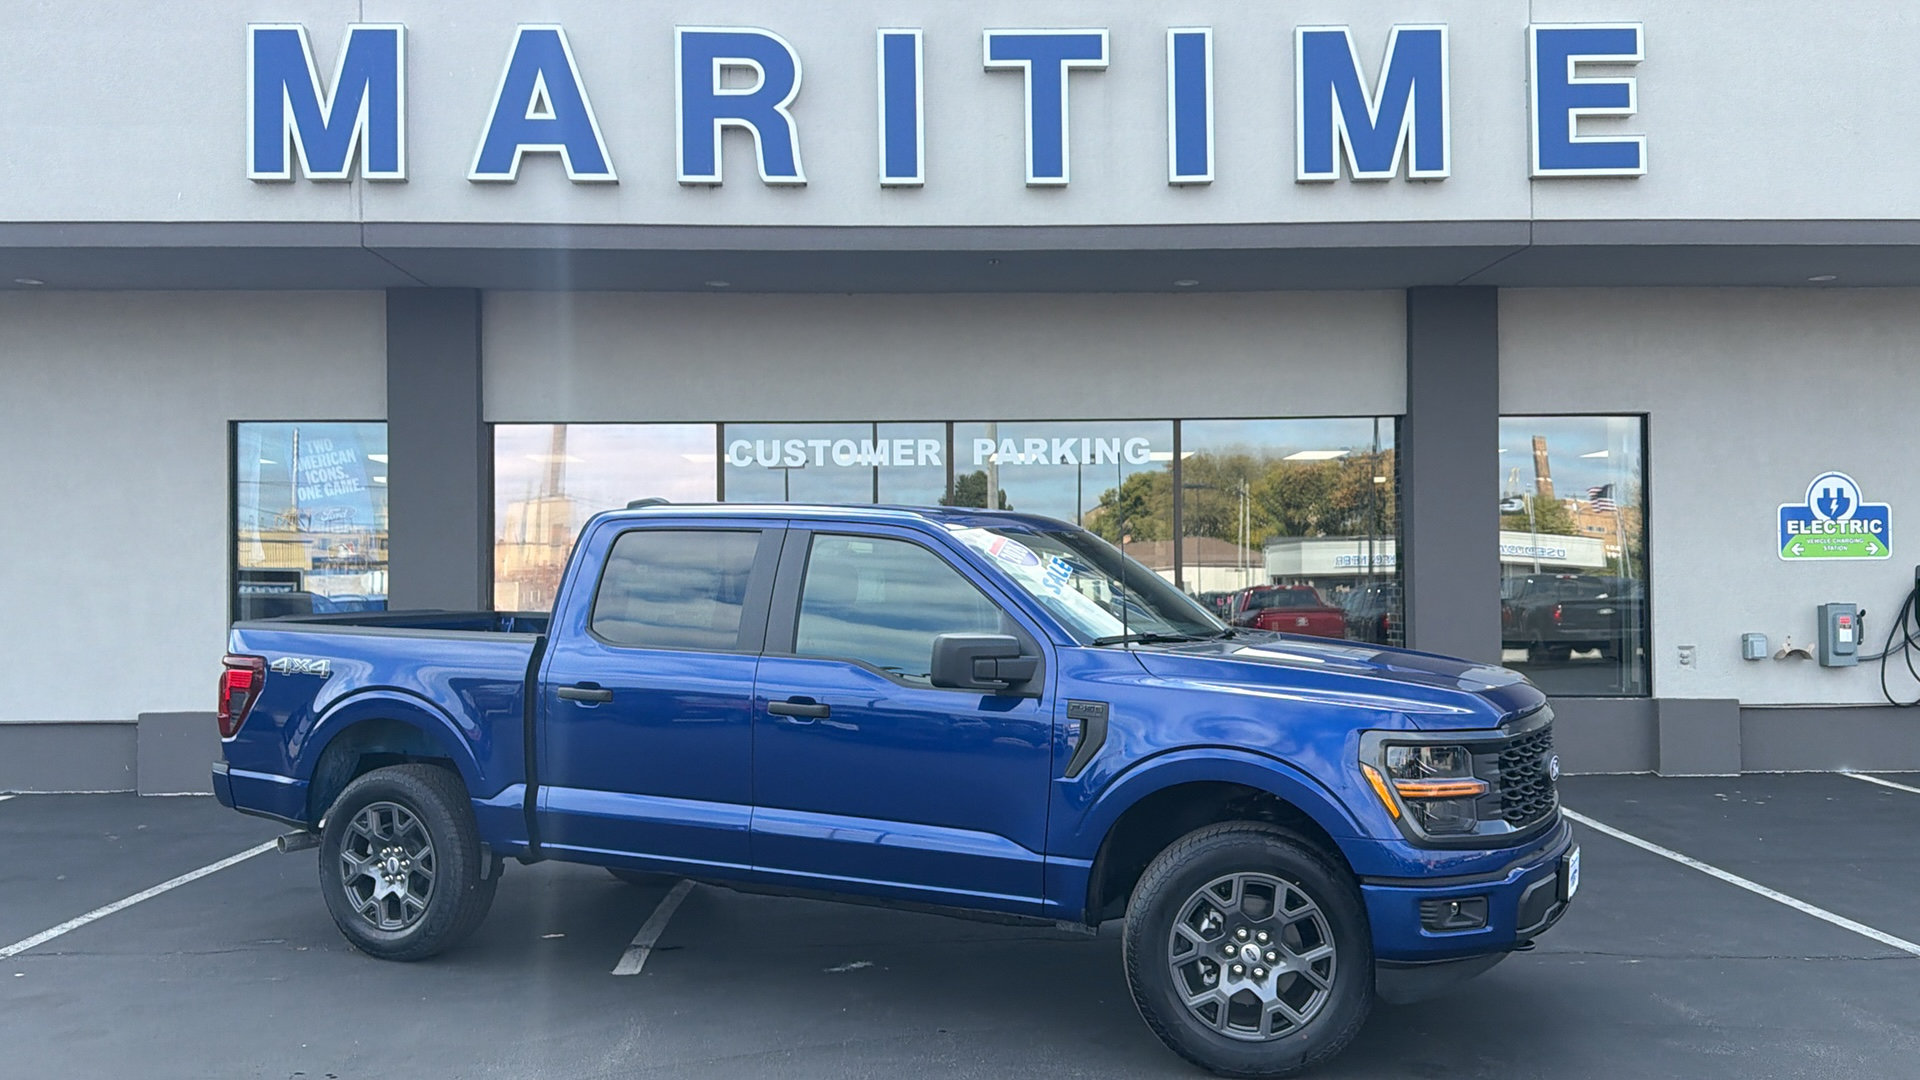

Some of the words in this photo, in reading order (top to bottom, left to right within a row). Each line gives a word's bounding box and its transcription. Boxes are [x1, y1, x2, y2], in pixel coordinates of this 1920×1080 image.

[246, 22, 1648, 186] MARITIME
[306, 438, 333, 454] TWO
[729, 438, 942, 467] CUSTOMER
[973, 437, 1150, 466] PARKING
[298, 448, 357, 471] MERICAN
[298, 484, 323, 501] ONE
[1787, 519, 1883, 534] ELECTRIC
[1043, 556, 1072, 595] SALE
